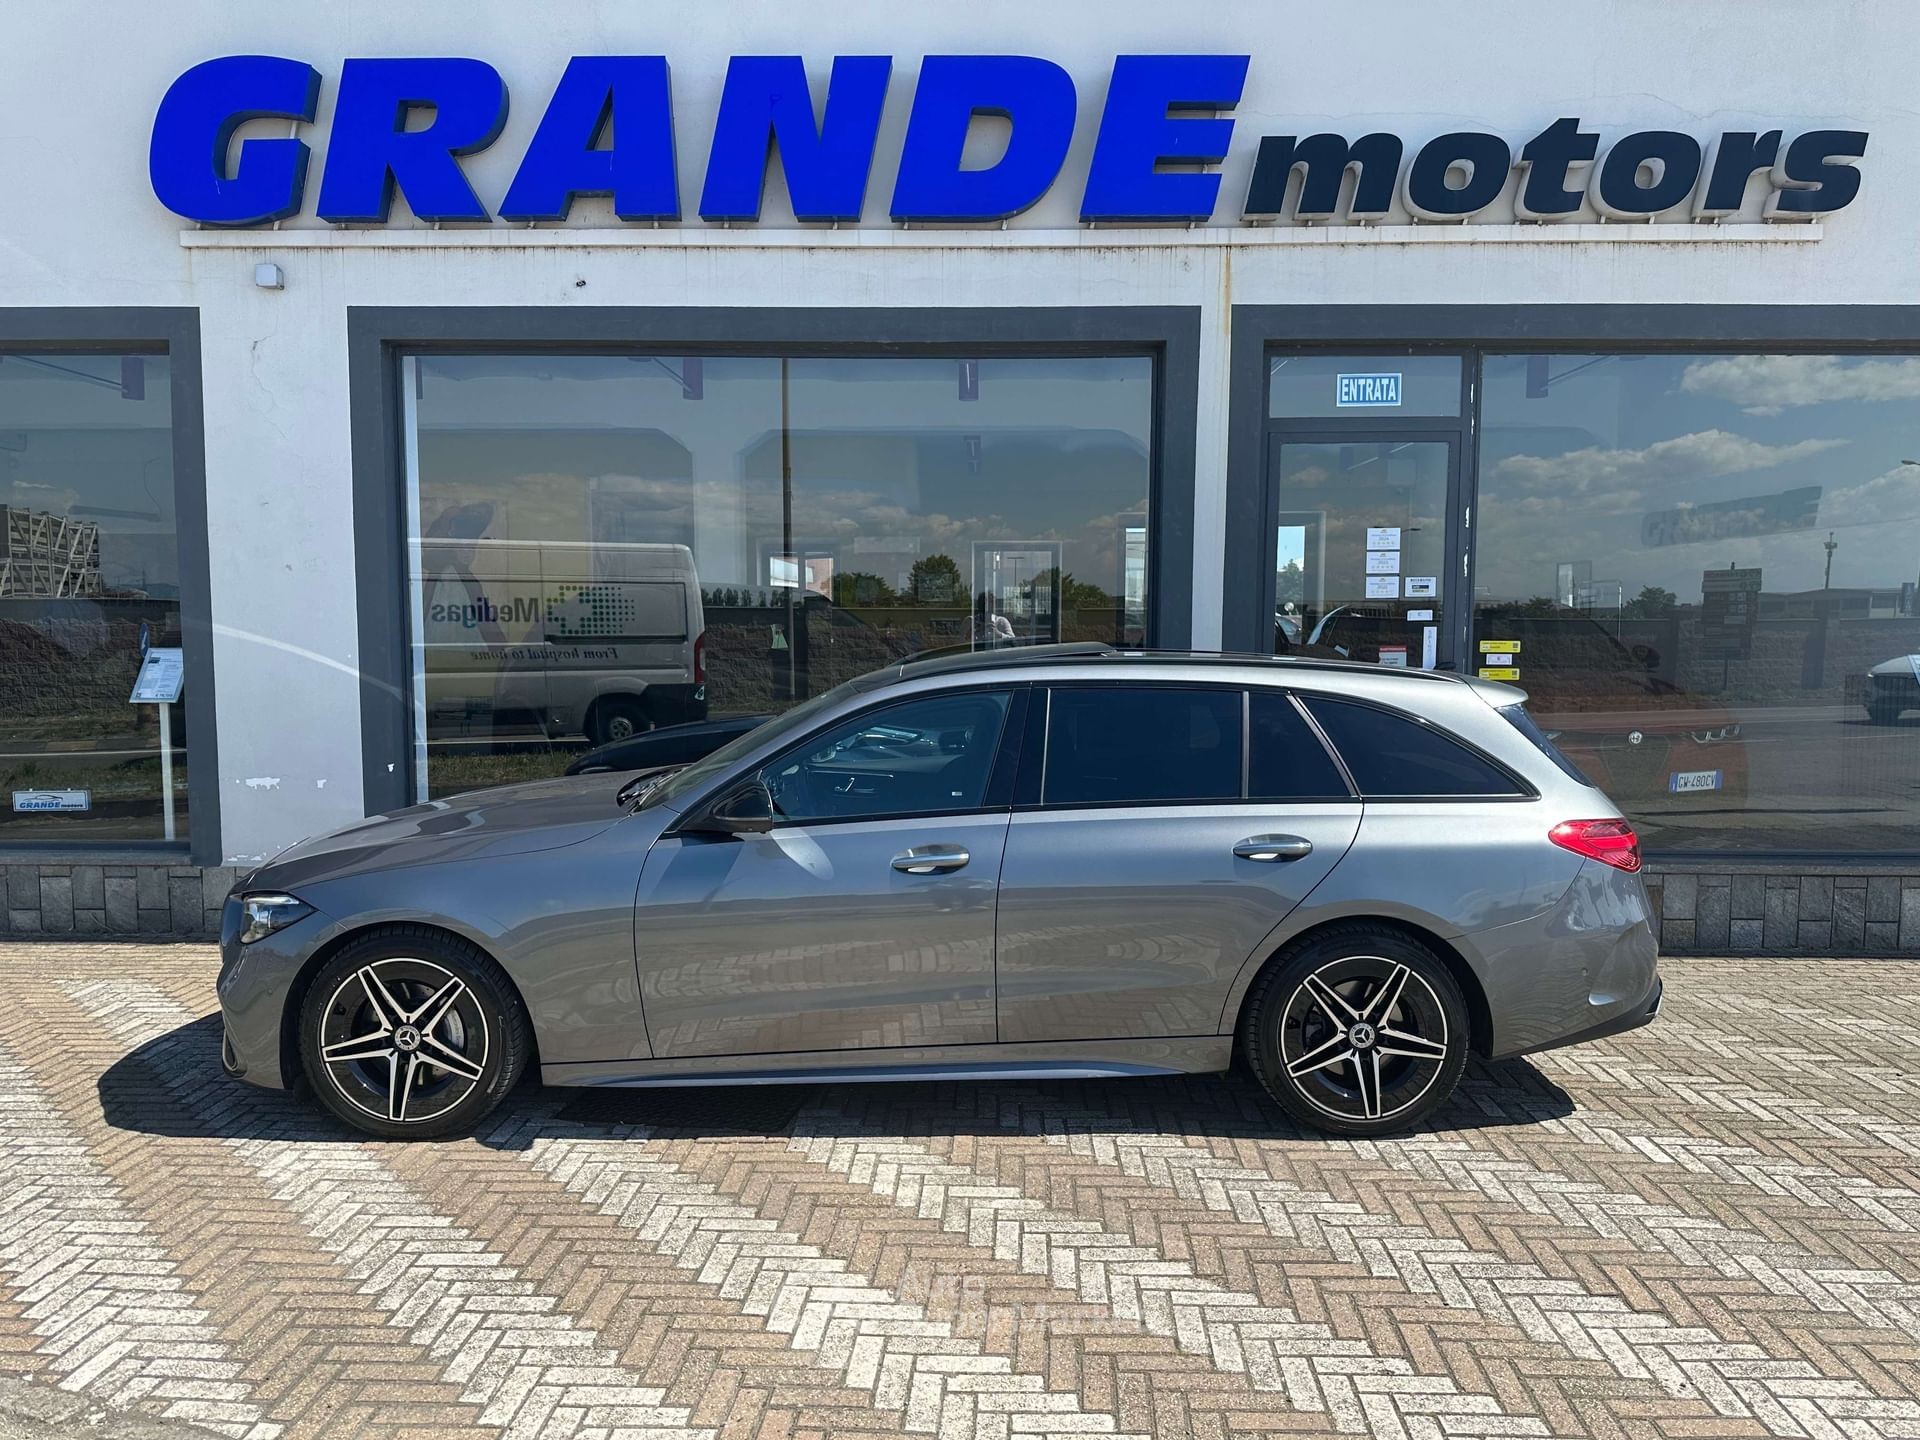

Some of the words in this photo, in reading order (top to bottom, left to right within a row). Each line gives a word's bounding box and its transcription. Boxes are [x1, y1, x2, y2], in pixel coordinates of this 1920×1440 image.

[149, 54, 1252, 227] GRANDE
[1243, 117, 1869, 221] motors
[1341, 378, 1396, 401] ENTRATA
[20, 801, 61, 809] GRANDE
